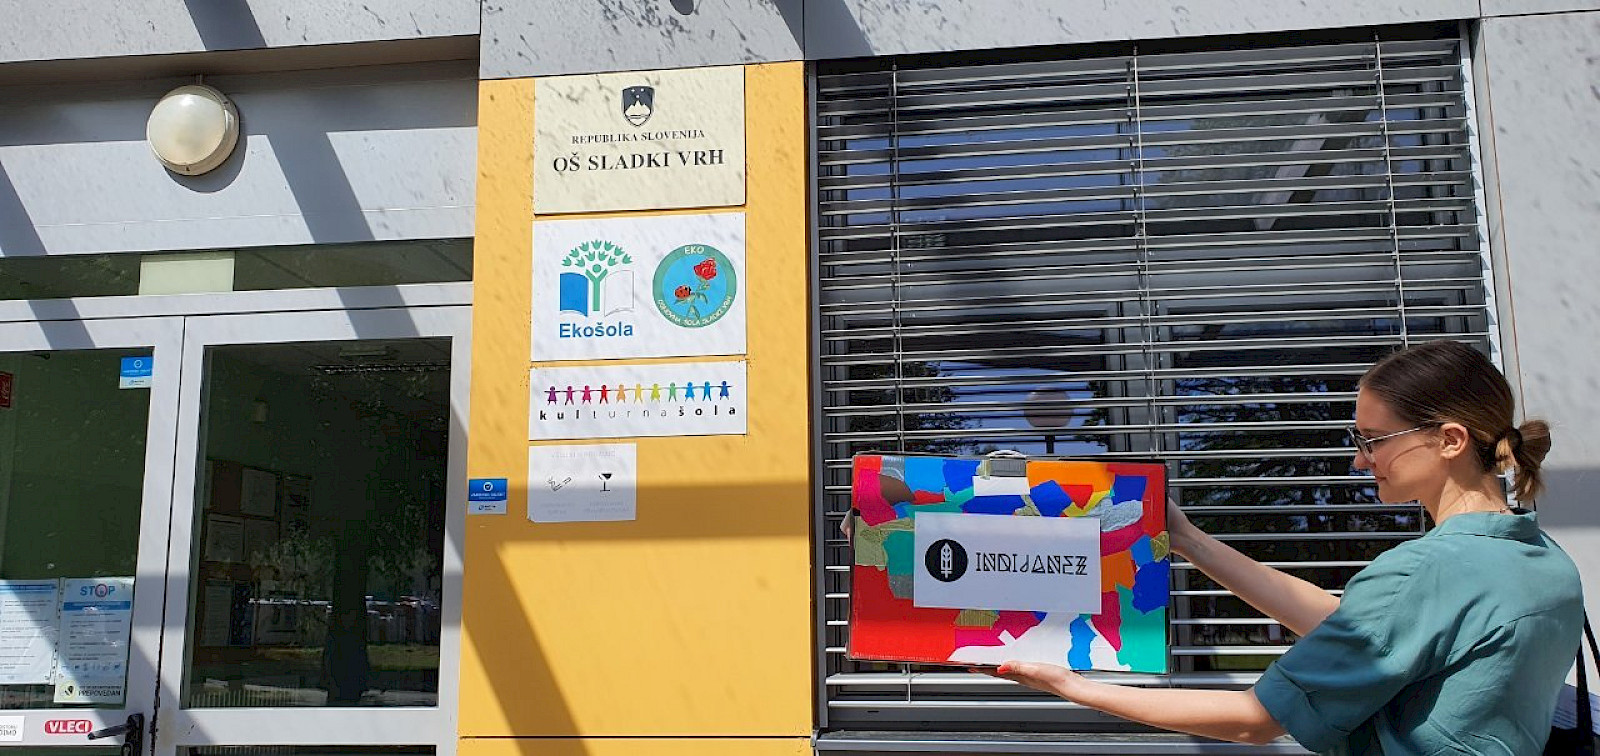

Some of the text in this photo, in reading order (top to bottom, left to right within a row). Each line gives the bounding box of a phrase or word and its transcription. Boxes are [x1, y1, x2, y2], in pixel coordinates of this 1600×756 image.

[571, 129, 706, 145] REPUBLIKA SLOVENIJA
[552, 149, 724, 172] OŠ SLADKI VRH
[684, 245, 705, 255] EKO
[559, 321, 634, 338] Ekošola
[975, 552, 1088, 576] INDIJANEZ
[79, 583, 116, 598] STOP
[49, 720, 89, 733] VLECI
